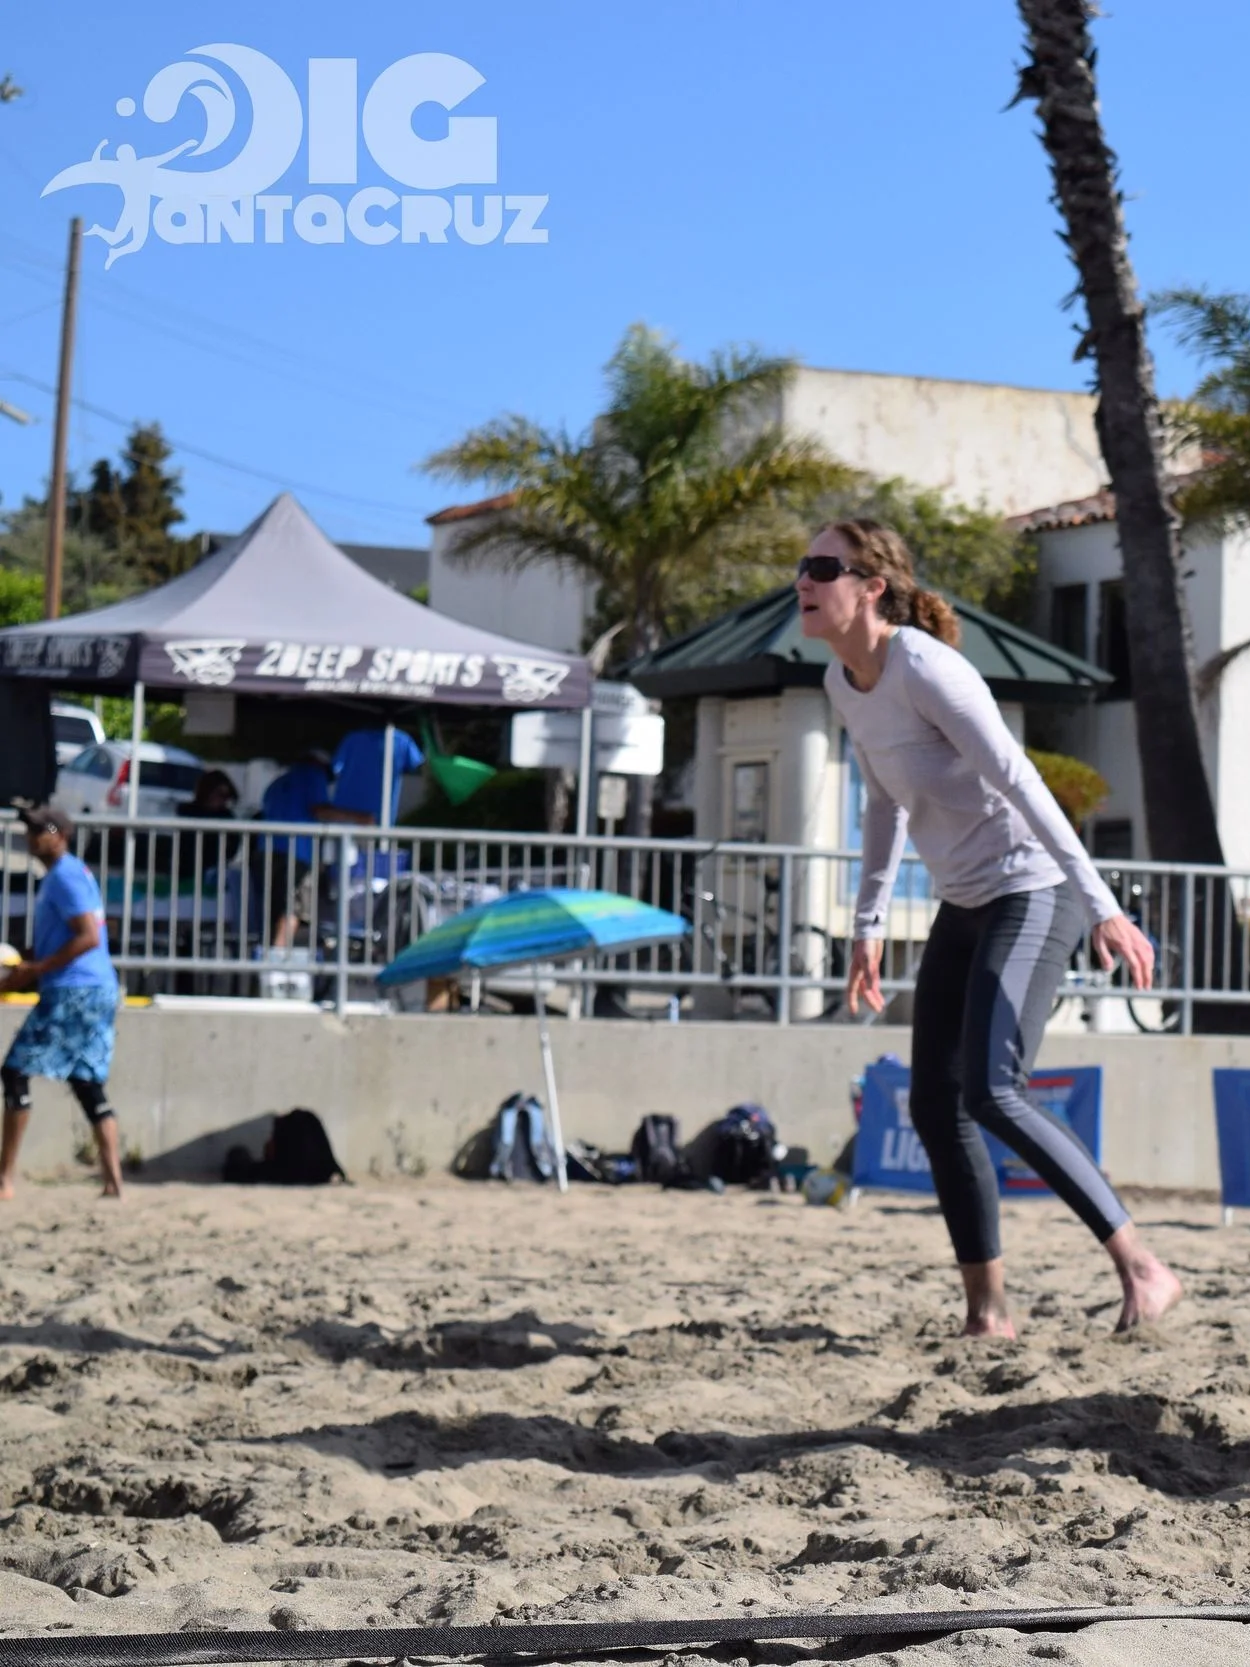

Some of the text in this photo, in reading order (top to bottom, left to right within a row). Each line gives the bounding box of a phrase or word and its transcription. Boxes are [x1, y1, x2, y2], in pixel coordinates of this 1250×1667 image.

[255, 639, 364, 680] 2DEEP
[367, 646, 485, 689] SPORTS
[879, 1127, 932, 1174] LIG
